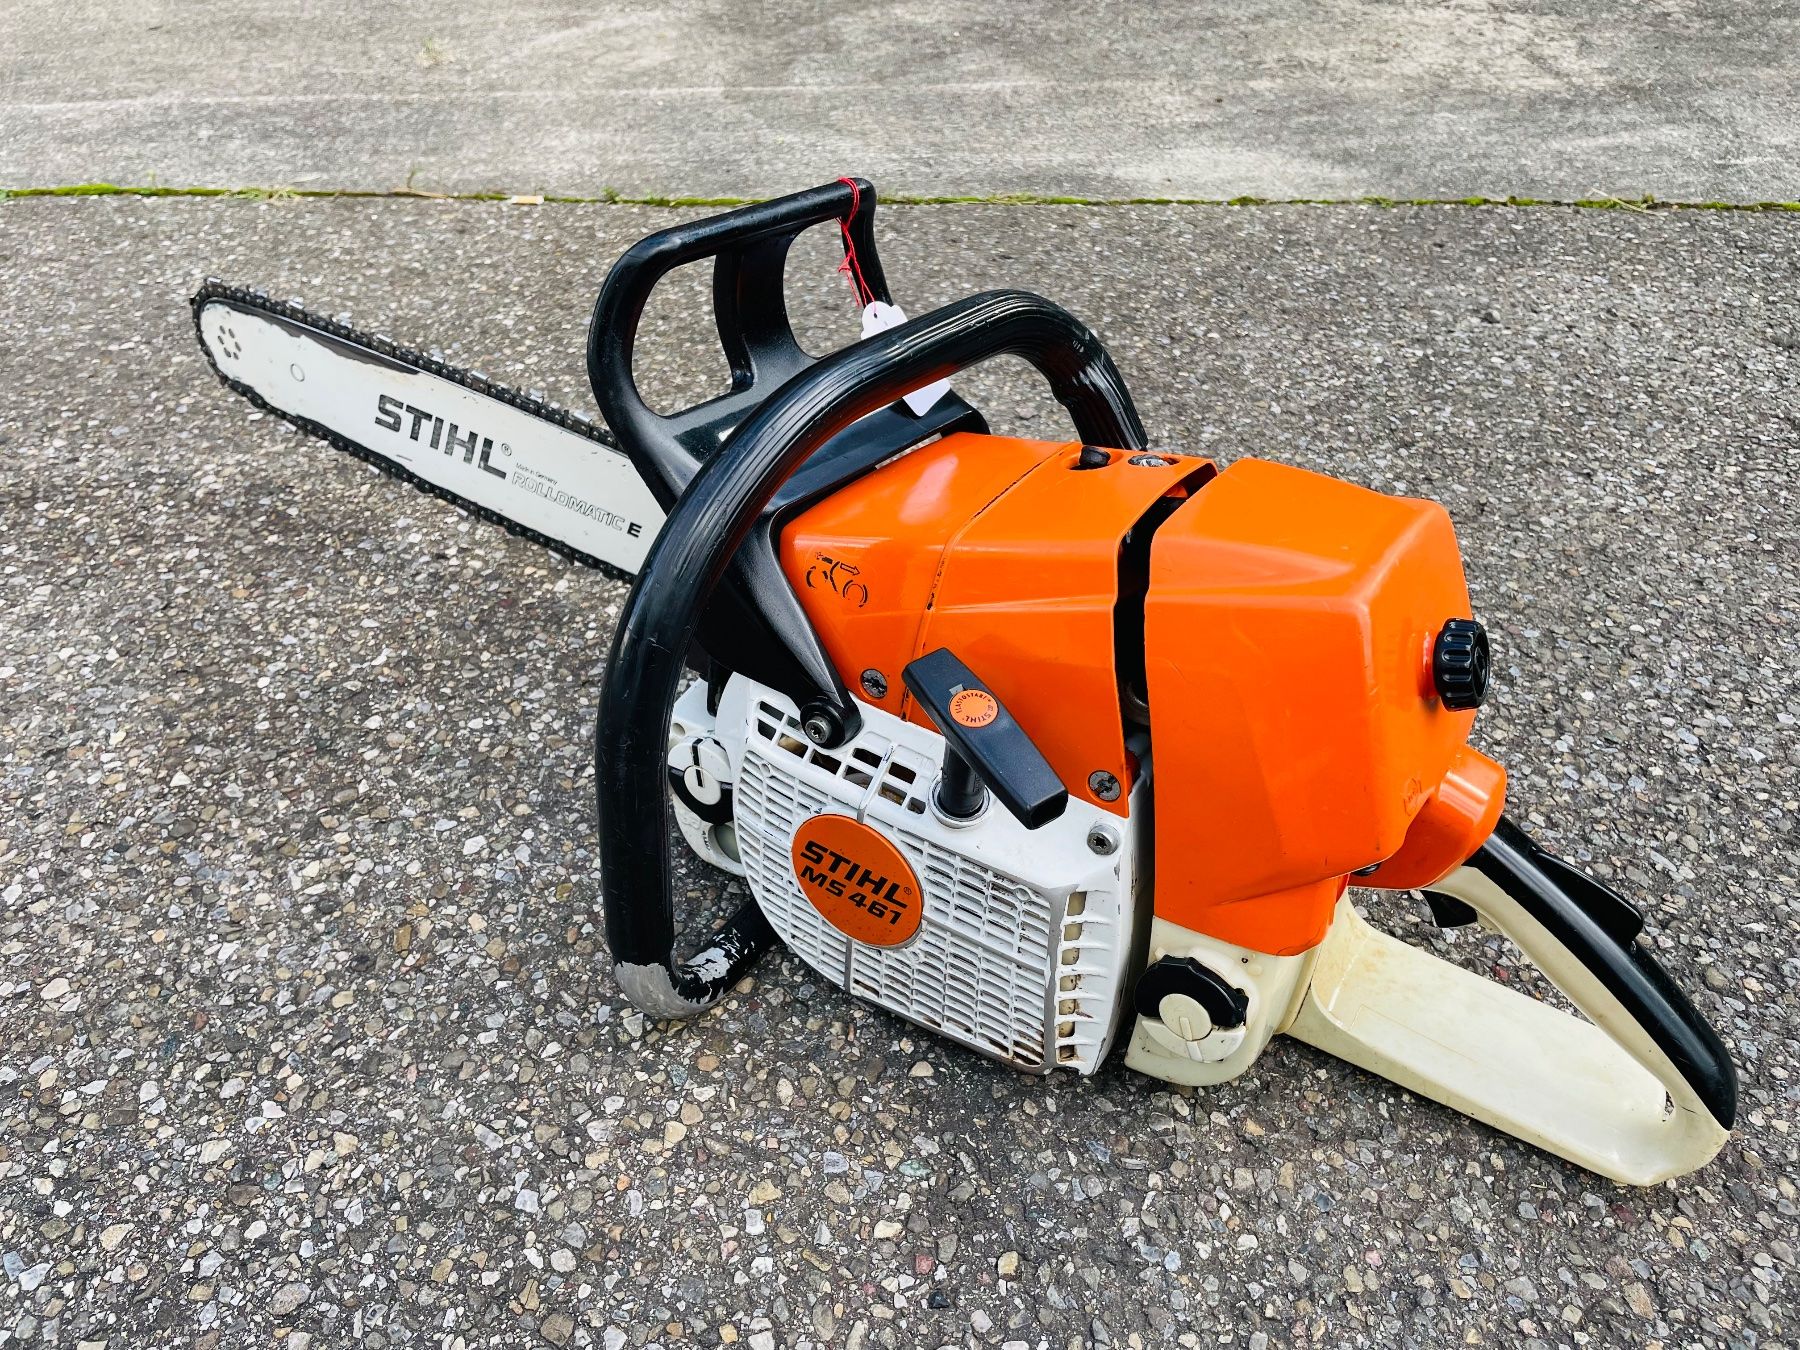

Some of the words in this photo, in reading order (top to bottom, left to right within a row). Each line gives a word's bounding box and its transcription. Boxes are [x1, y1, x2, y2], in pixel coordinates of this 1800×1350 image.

[375, 394, 507, 480] STIHL
[516, 462, 529, 472] Made
[512, 471, 625, 531] ROLLOMATIC
[627, 522, 642, 538] E
[800, 840, 908, 909] STIHL
[800, 865, 846, 897] MS
[848, 892, 902, 925] 461
